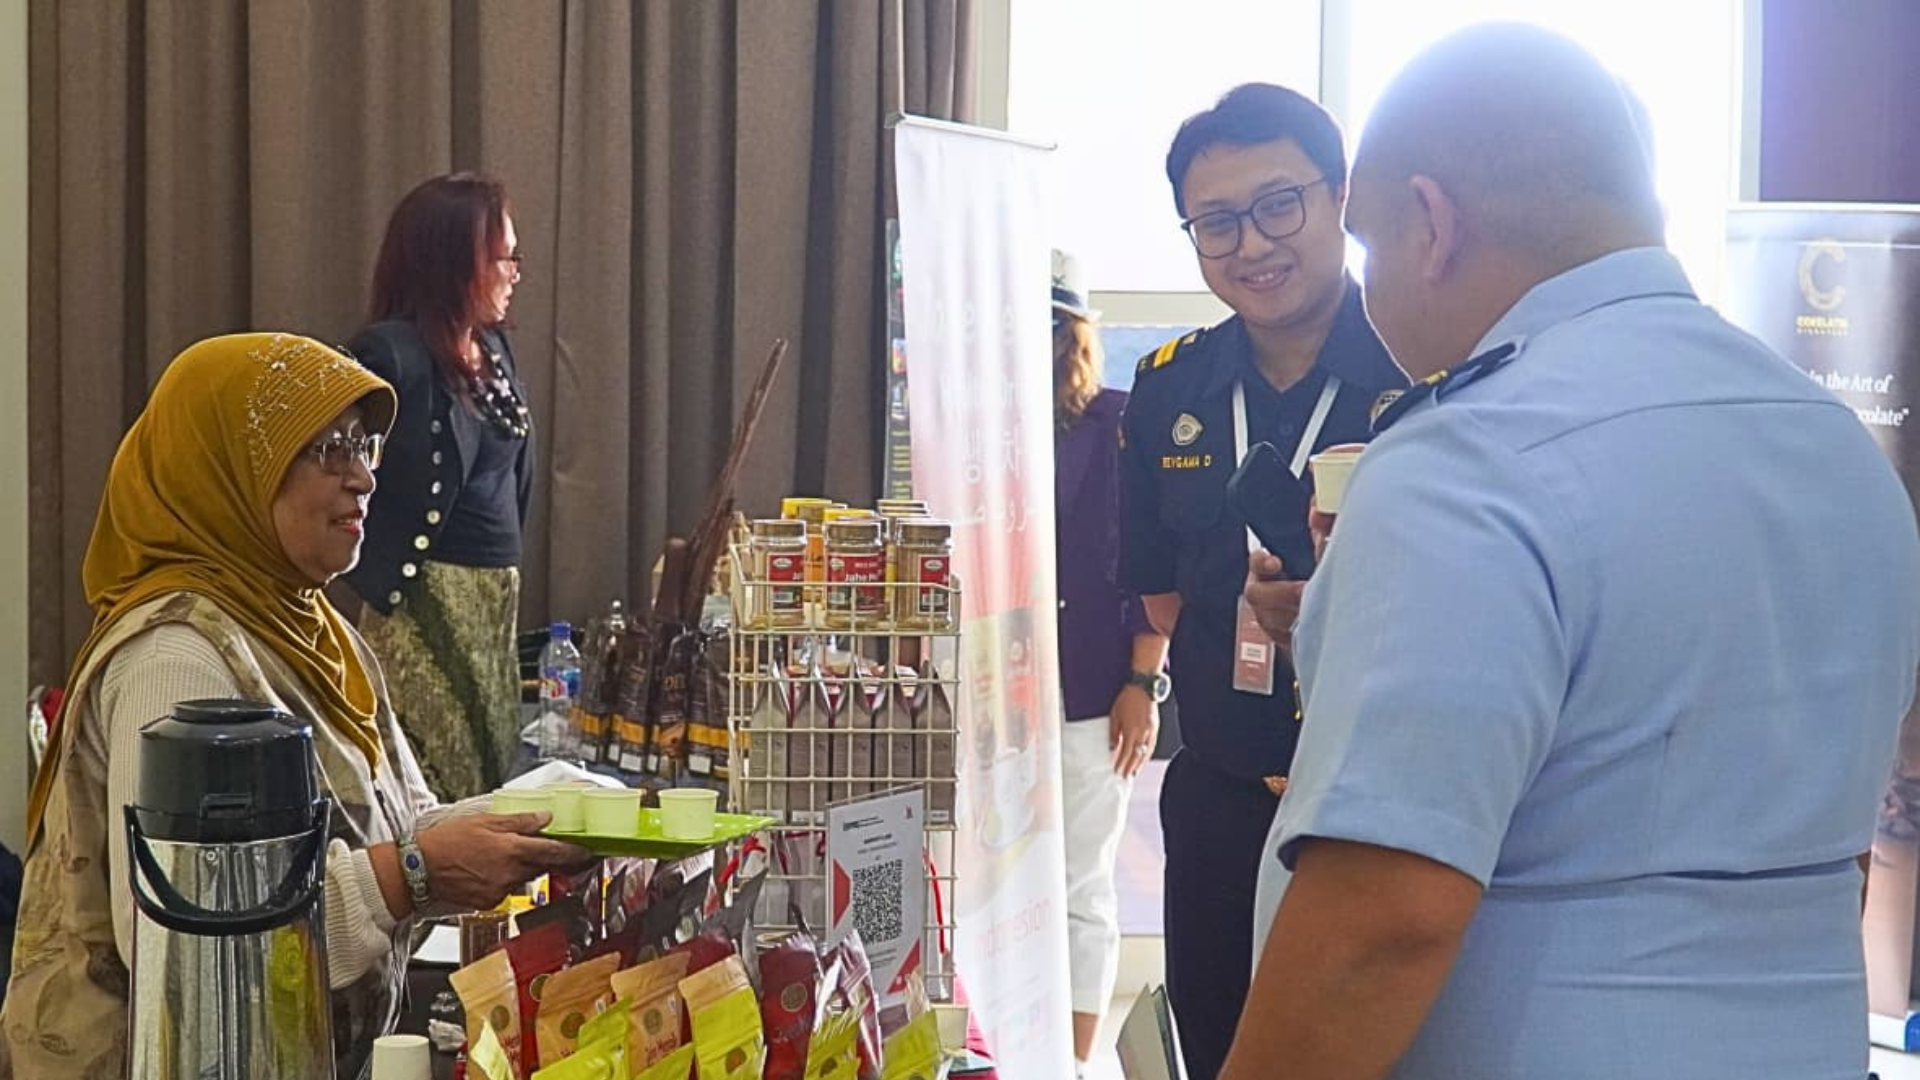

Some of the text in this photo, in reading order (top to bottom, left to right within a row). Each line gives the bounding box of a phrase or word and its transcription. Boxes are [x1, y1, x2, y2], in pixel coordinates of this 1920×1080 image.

[1797, 236, 1846, 310] C
[1826, 370, 1850, 391] the
[1850, 373, 1873, 392] Art
[1874, 374, 1894, 394] of
[1204, 454, 1212, 467] D
